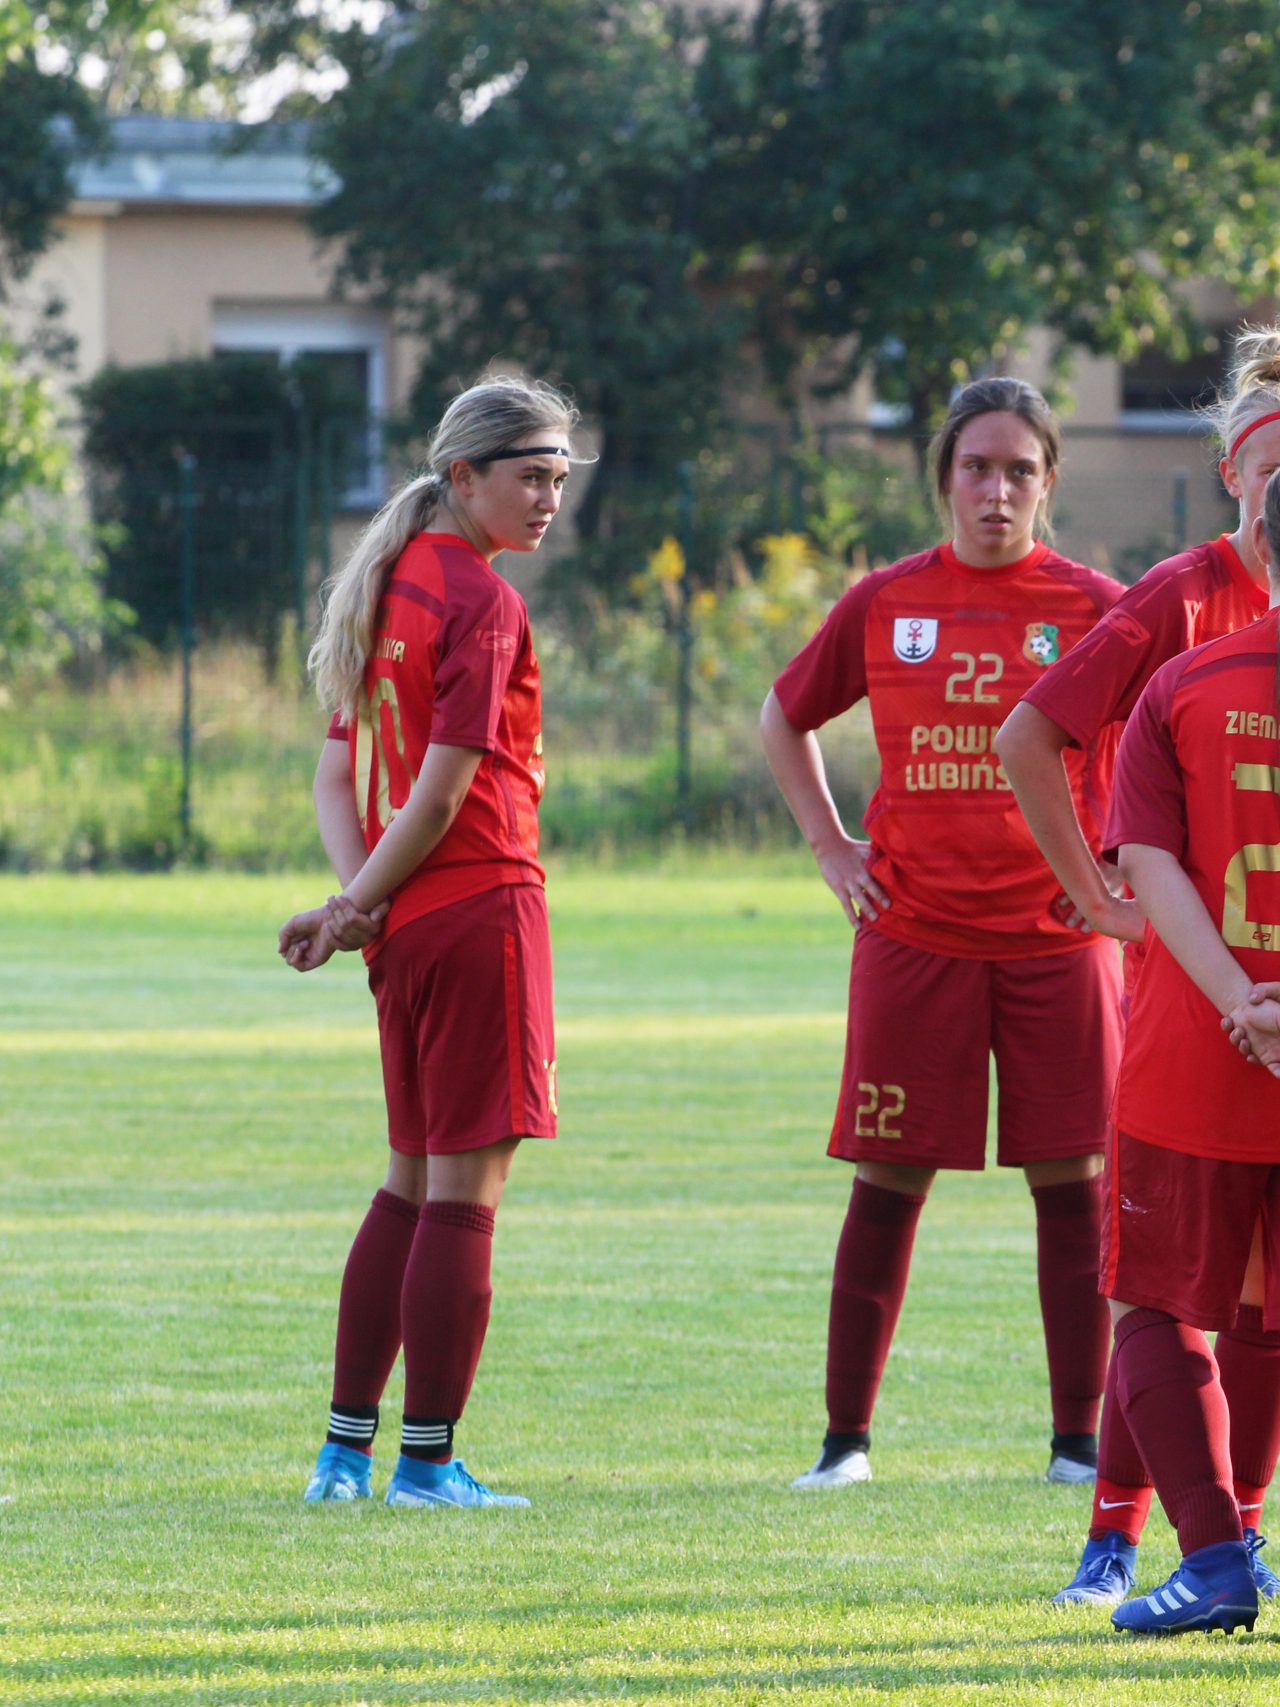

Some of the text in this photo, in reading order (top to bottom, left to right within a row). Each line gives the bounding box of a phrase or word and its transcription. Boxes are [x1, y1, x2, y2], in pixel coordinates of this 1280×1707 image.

[945, 652, 1004, 704] 22
[1225, 710, 1280, 740] ZIEM
[855, 1082, 906, 1139] 22
